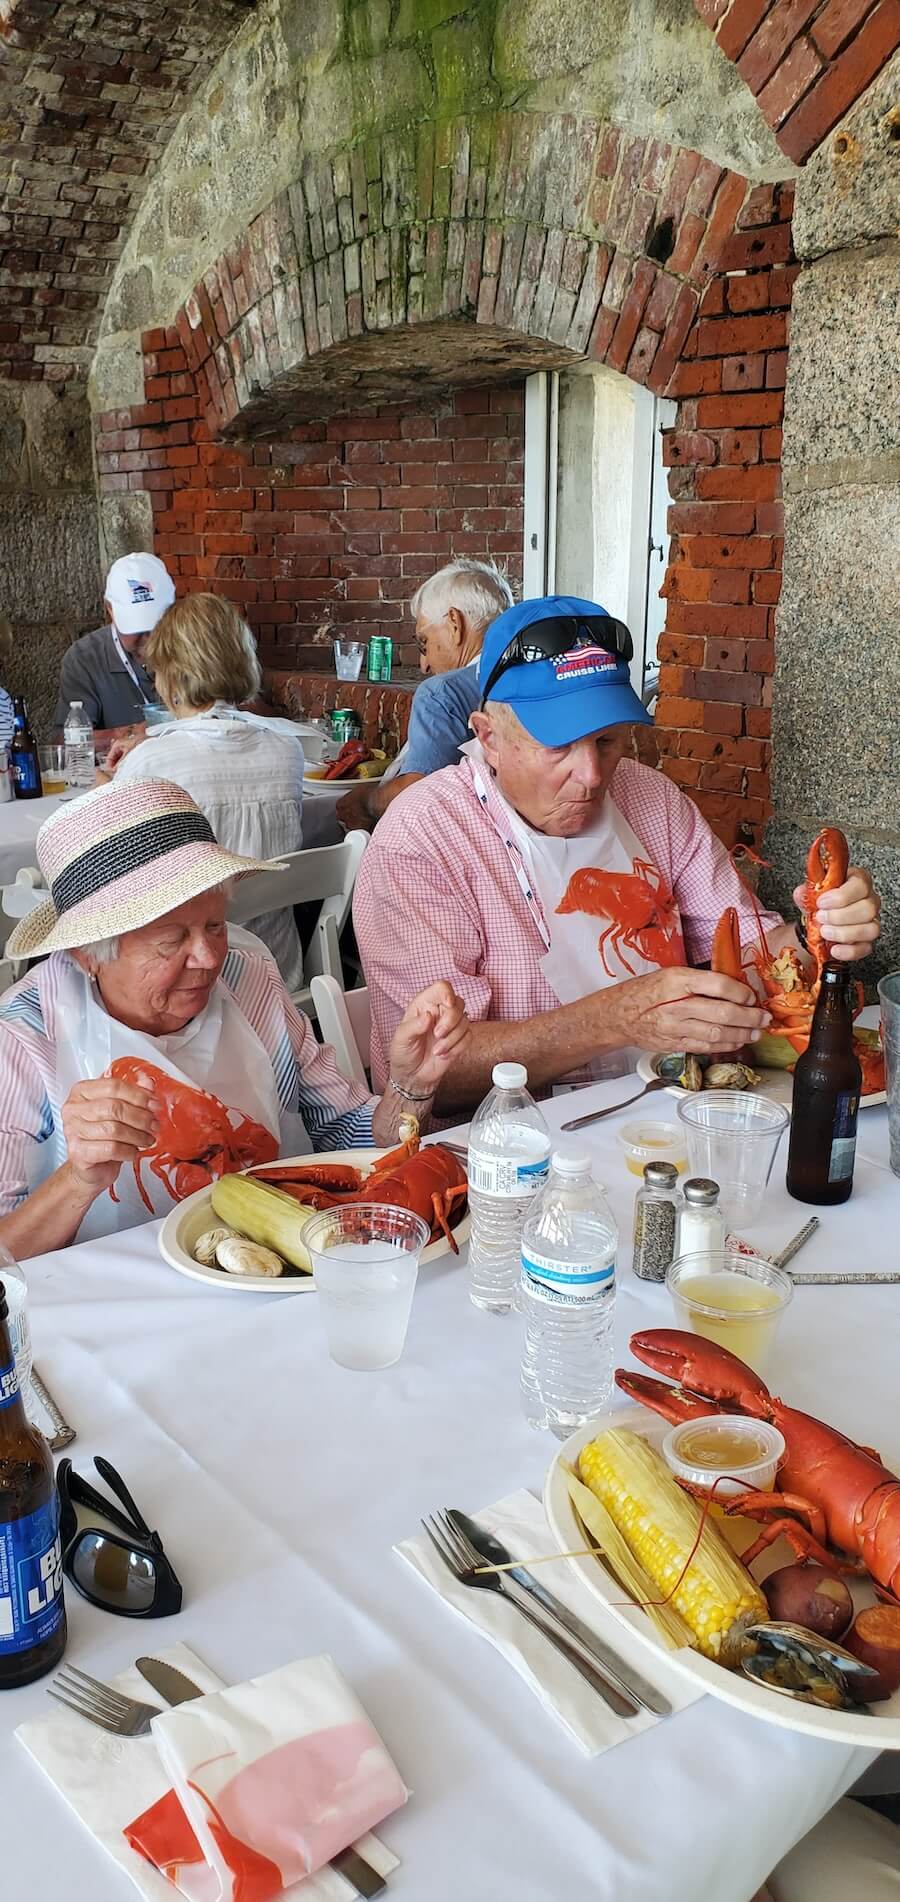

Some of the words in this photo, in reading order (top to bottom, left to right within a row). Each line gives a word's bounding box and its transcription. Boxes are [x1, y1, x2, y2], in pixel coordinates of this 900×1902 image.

[556, 667, 595, 681] CRUISE
[1, 1370, 18, 1388] BU
[39, 1530, 62, 1582] BU
[27, 1559, 63, 1616] LIG
